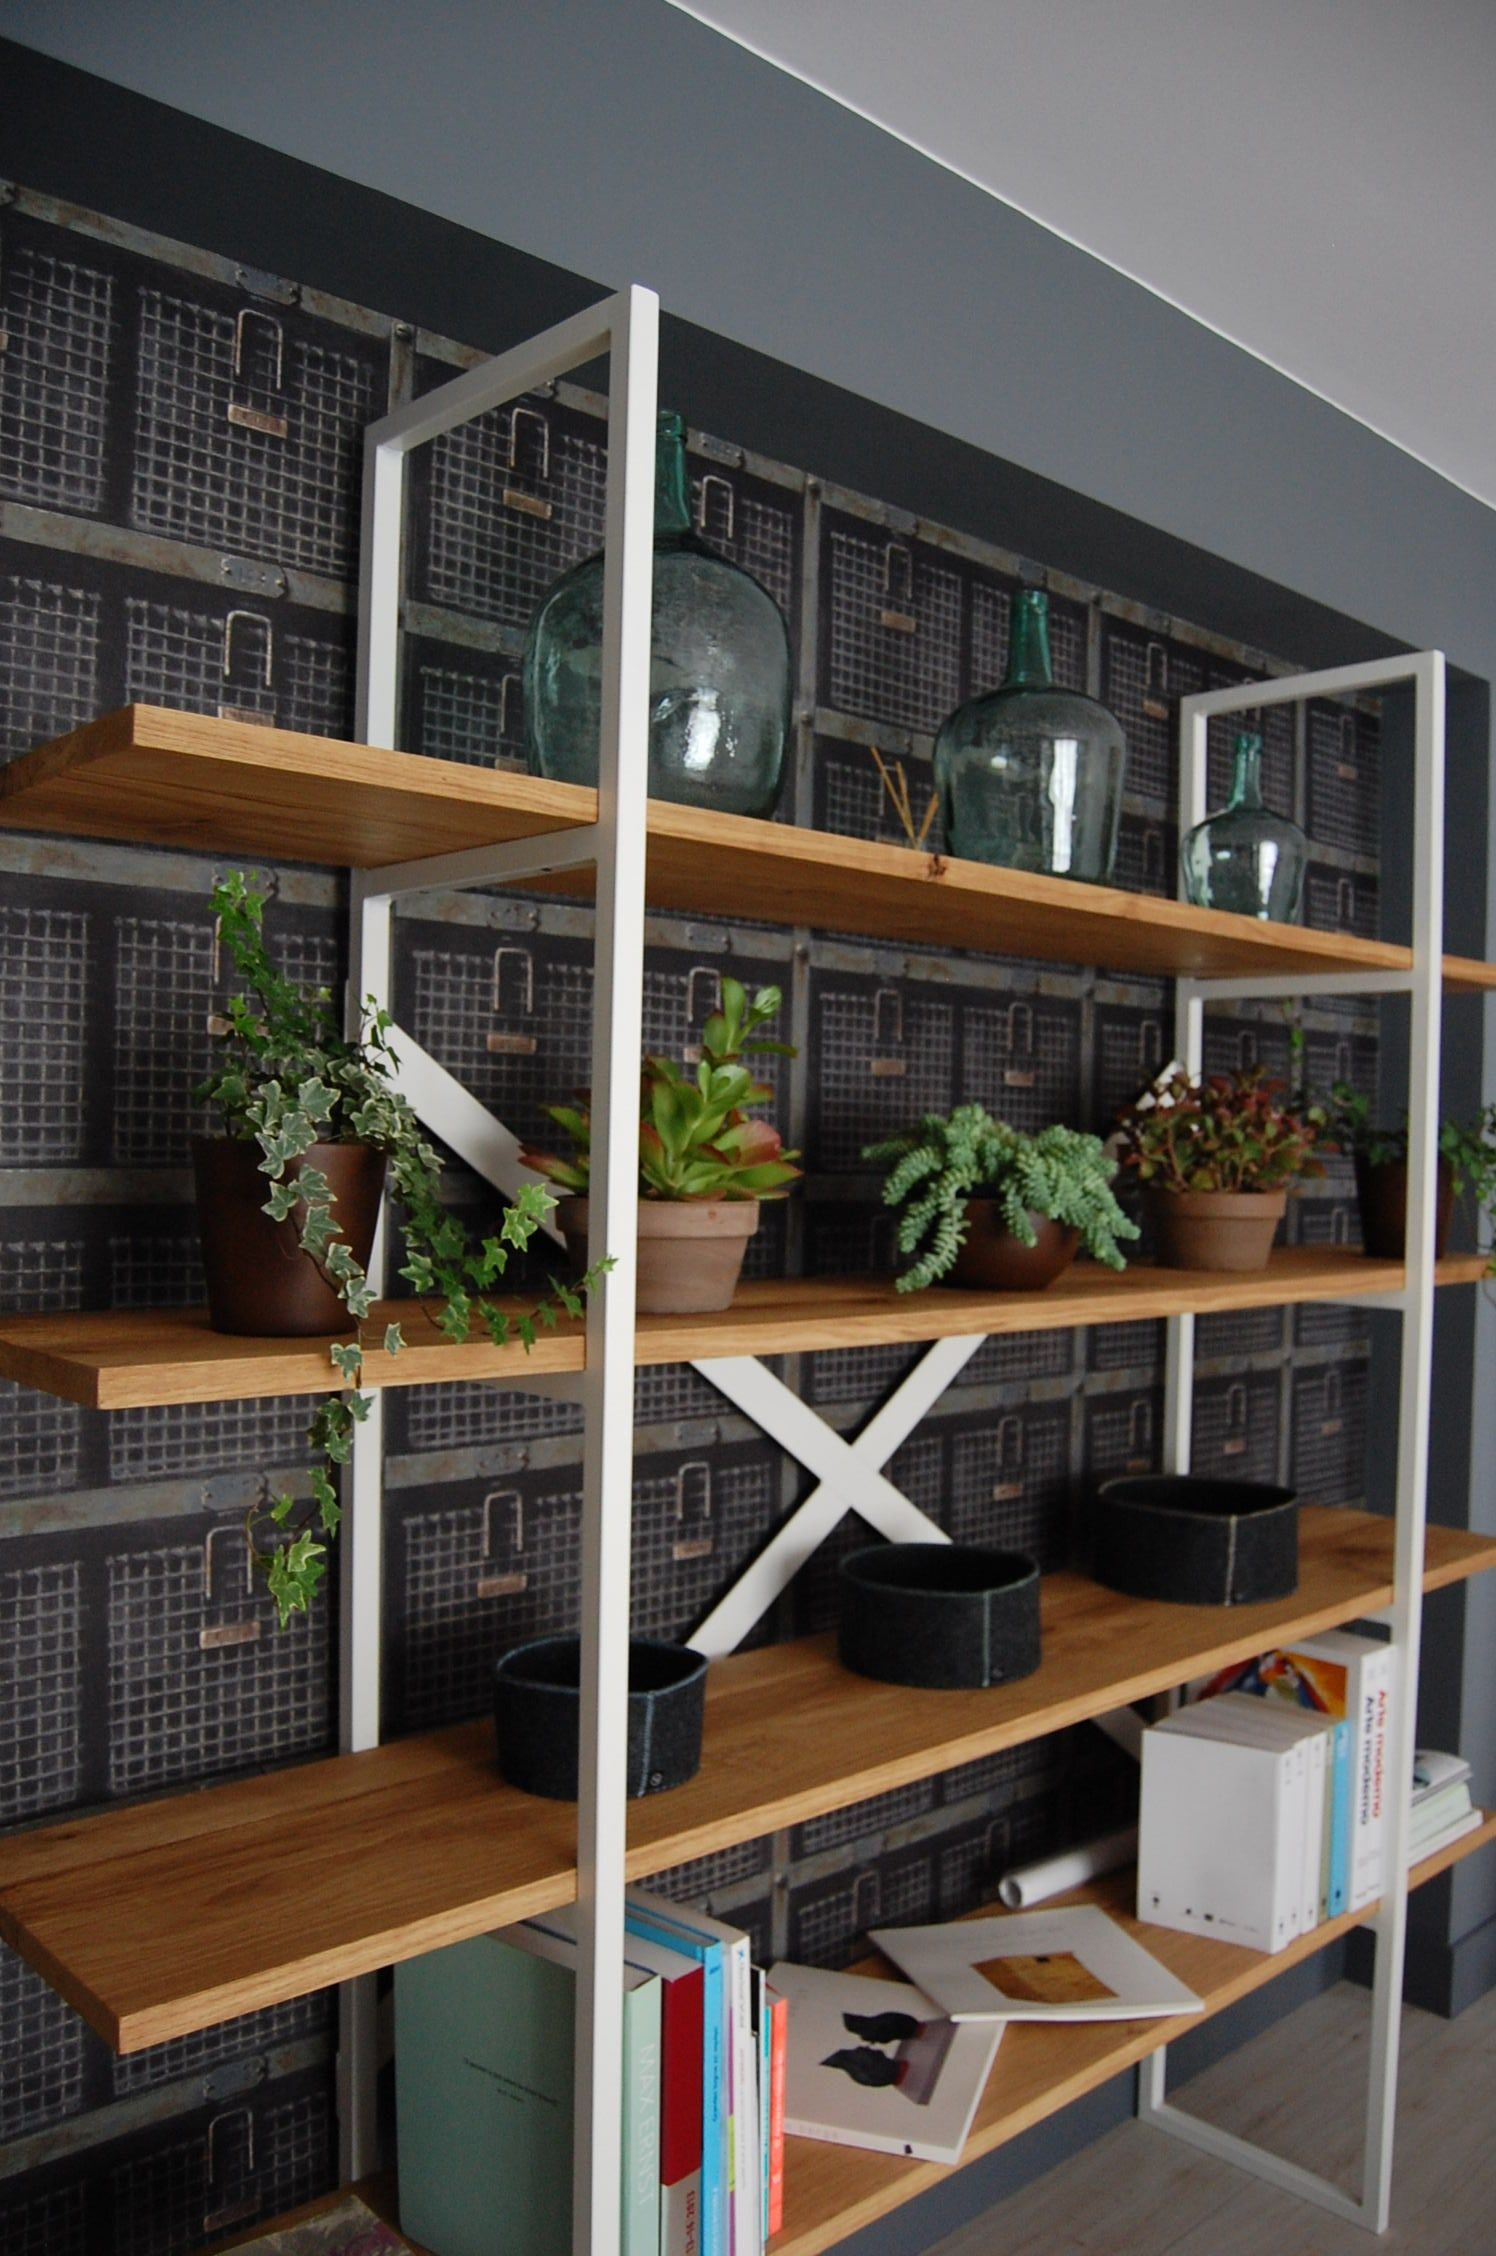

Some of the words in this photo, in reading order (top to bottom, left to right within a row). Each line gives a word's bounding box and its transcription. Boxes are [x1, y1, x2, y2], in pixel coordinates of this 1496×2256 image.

[1363, 1696, 1375, 1734] Arte
[1375, 1689, 1387, 1727] Arte
[639, 2042, 656, 2115] MAX
[639, 2114, 655, 2206] ERNST
